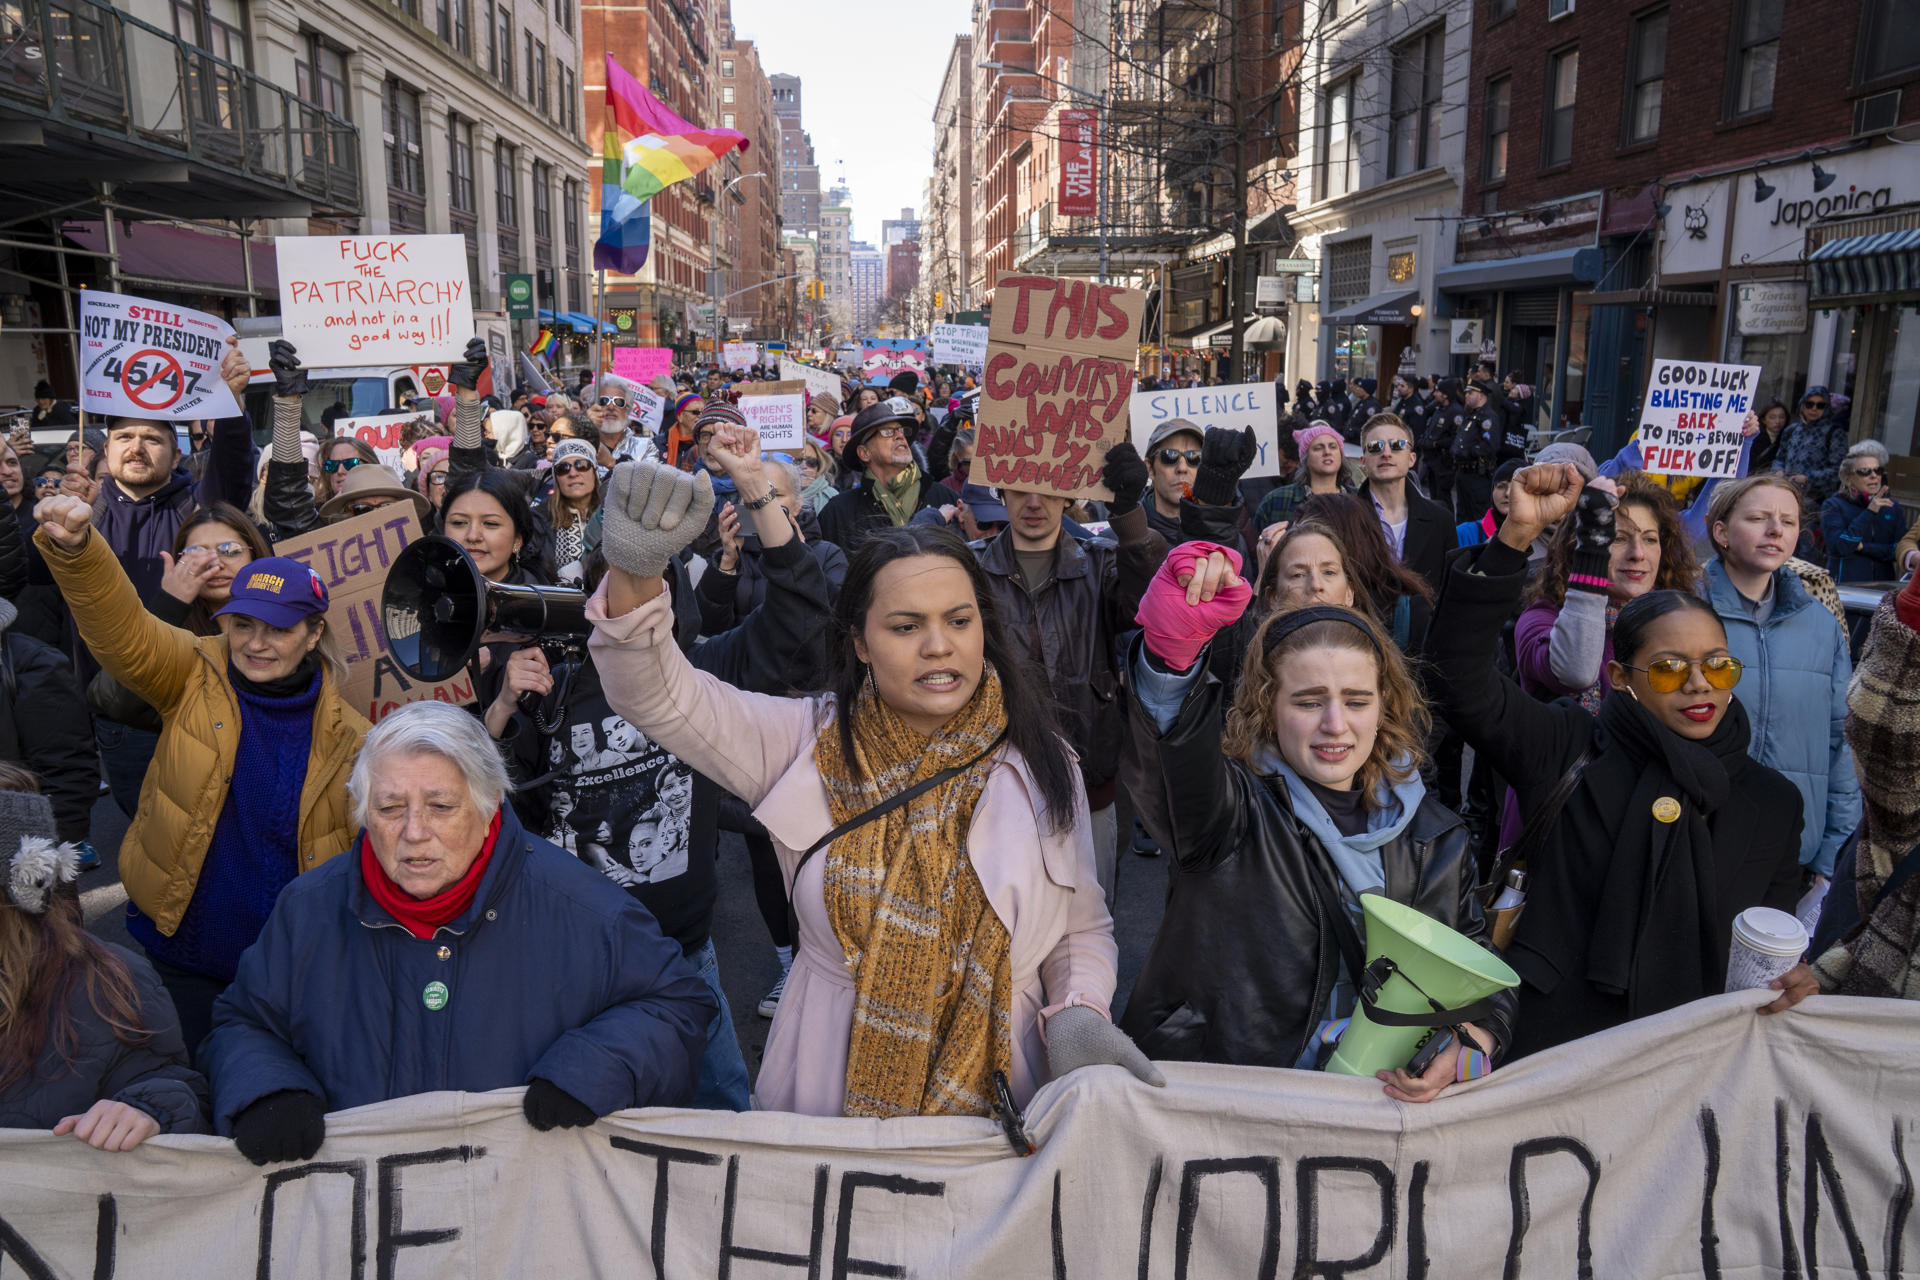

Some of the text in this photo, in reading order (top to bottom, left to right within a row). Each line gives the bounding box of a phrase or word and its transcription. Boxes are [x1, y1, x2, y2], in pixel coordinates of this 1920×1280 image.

[1078, 125, 1092, 197] VILLAGE
[1065, 161, 1079, 197] THE
[1770, 185, 1892, 228] Japonica
[340, 240, 409, 262] FUCK
[354, 264, 386, 278] THE
[290, 280, 463, 306] PATRIARCHY
[128, 305, 184, 328] STILL
[361, 310, 386, 326] not
[393, 310, 405, 325] in
[410, 315, 419, 324] a
[998, 275, 1130, 341] THIS
[1751, 302, 1802, 316] Taquitos
[84, 315, 222, 361] NOT MY PRESIDENT
[87, 340, 103, 348] LIAR
[348, 328, 390, 350] good
[934, 326, 957, 337] STOP
[189, 360, 212, 371] THIEF
[880, 359, 907, 368] With
[985, 352, 1134, 424] COUNTRY
[1658, 365, 1750, 391] GOOD LUCK
[632, 391, 657, 409] ESIDENT
[740, 404, 793, 420] WOMEN'S
[1151, 391, 1261, 419] SILENCE
[1650, 388, 1748, 414] BLASTING ME
[759, 414, 793, 424] RIGHTS
[1027, 393, 1108, 441] WAS
[760, 431, 793, 440] RIGHTS
[975, 419, 1091, 468] BUILT BY
[1642, 424, 1663, 440] TO
[1666, 429, 1694, 446] 1950
[1707, 430, 1744, 447] BEYOND
[984, 455, 1104, 491] WOMEN
[1642, 445, 1740, 475] FUCK OFF!
[250, 573, 285, 587] MARCH
[373, 655, 413, 699] A
[574, 754, 666, 787] Excellence
[608, 1135, 946, 1280] THE
